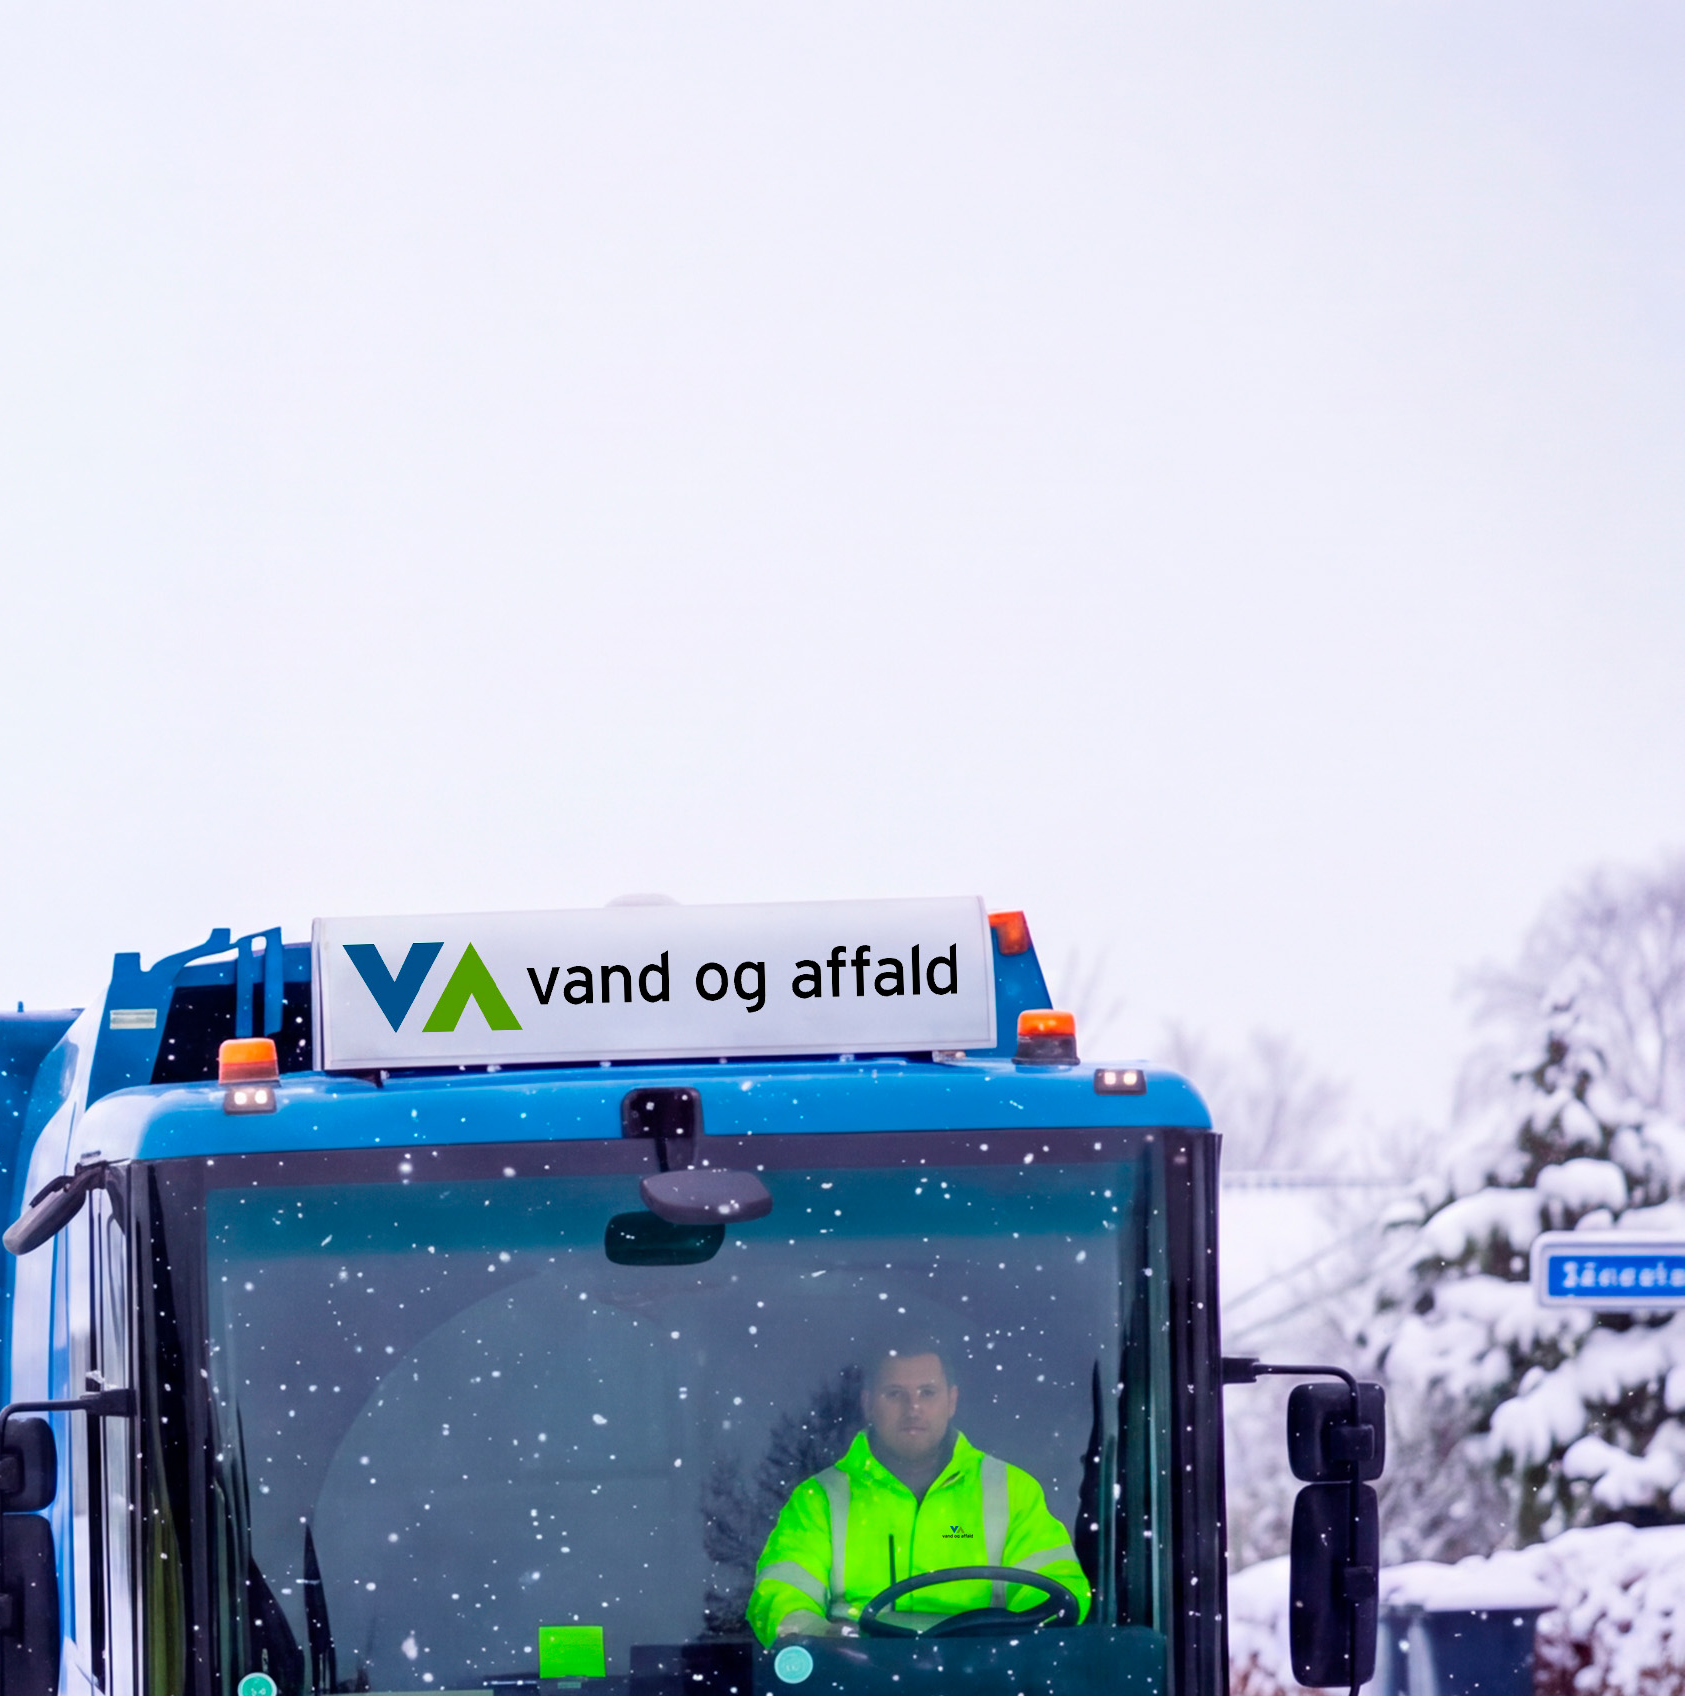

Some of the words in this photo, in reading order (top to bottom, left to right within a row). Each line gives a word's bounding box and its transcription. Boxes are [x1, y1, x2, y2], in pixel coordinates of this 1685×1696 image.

[342, 941, 523, 1033] VA
[527, 950, 670, 1005] vand
[695, 962, 766, 1014] og
[791, 942, 958, 1000] affald
